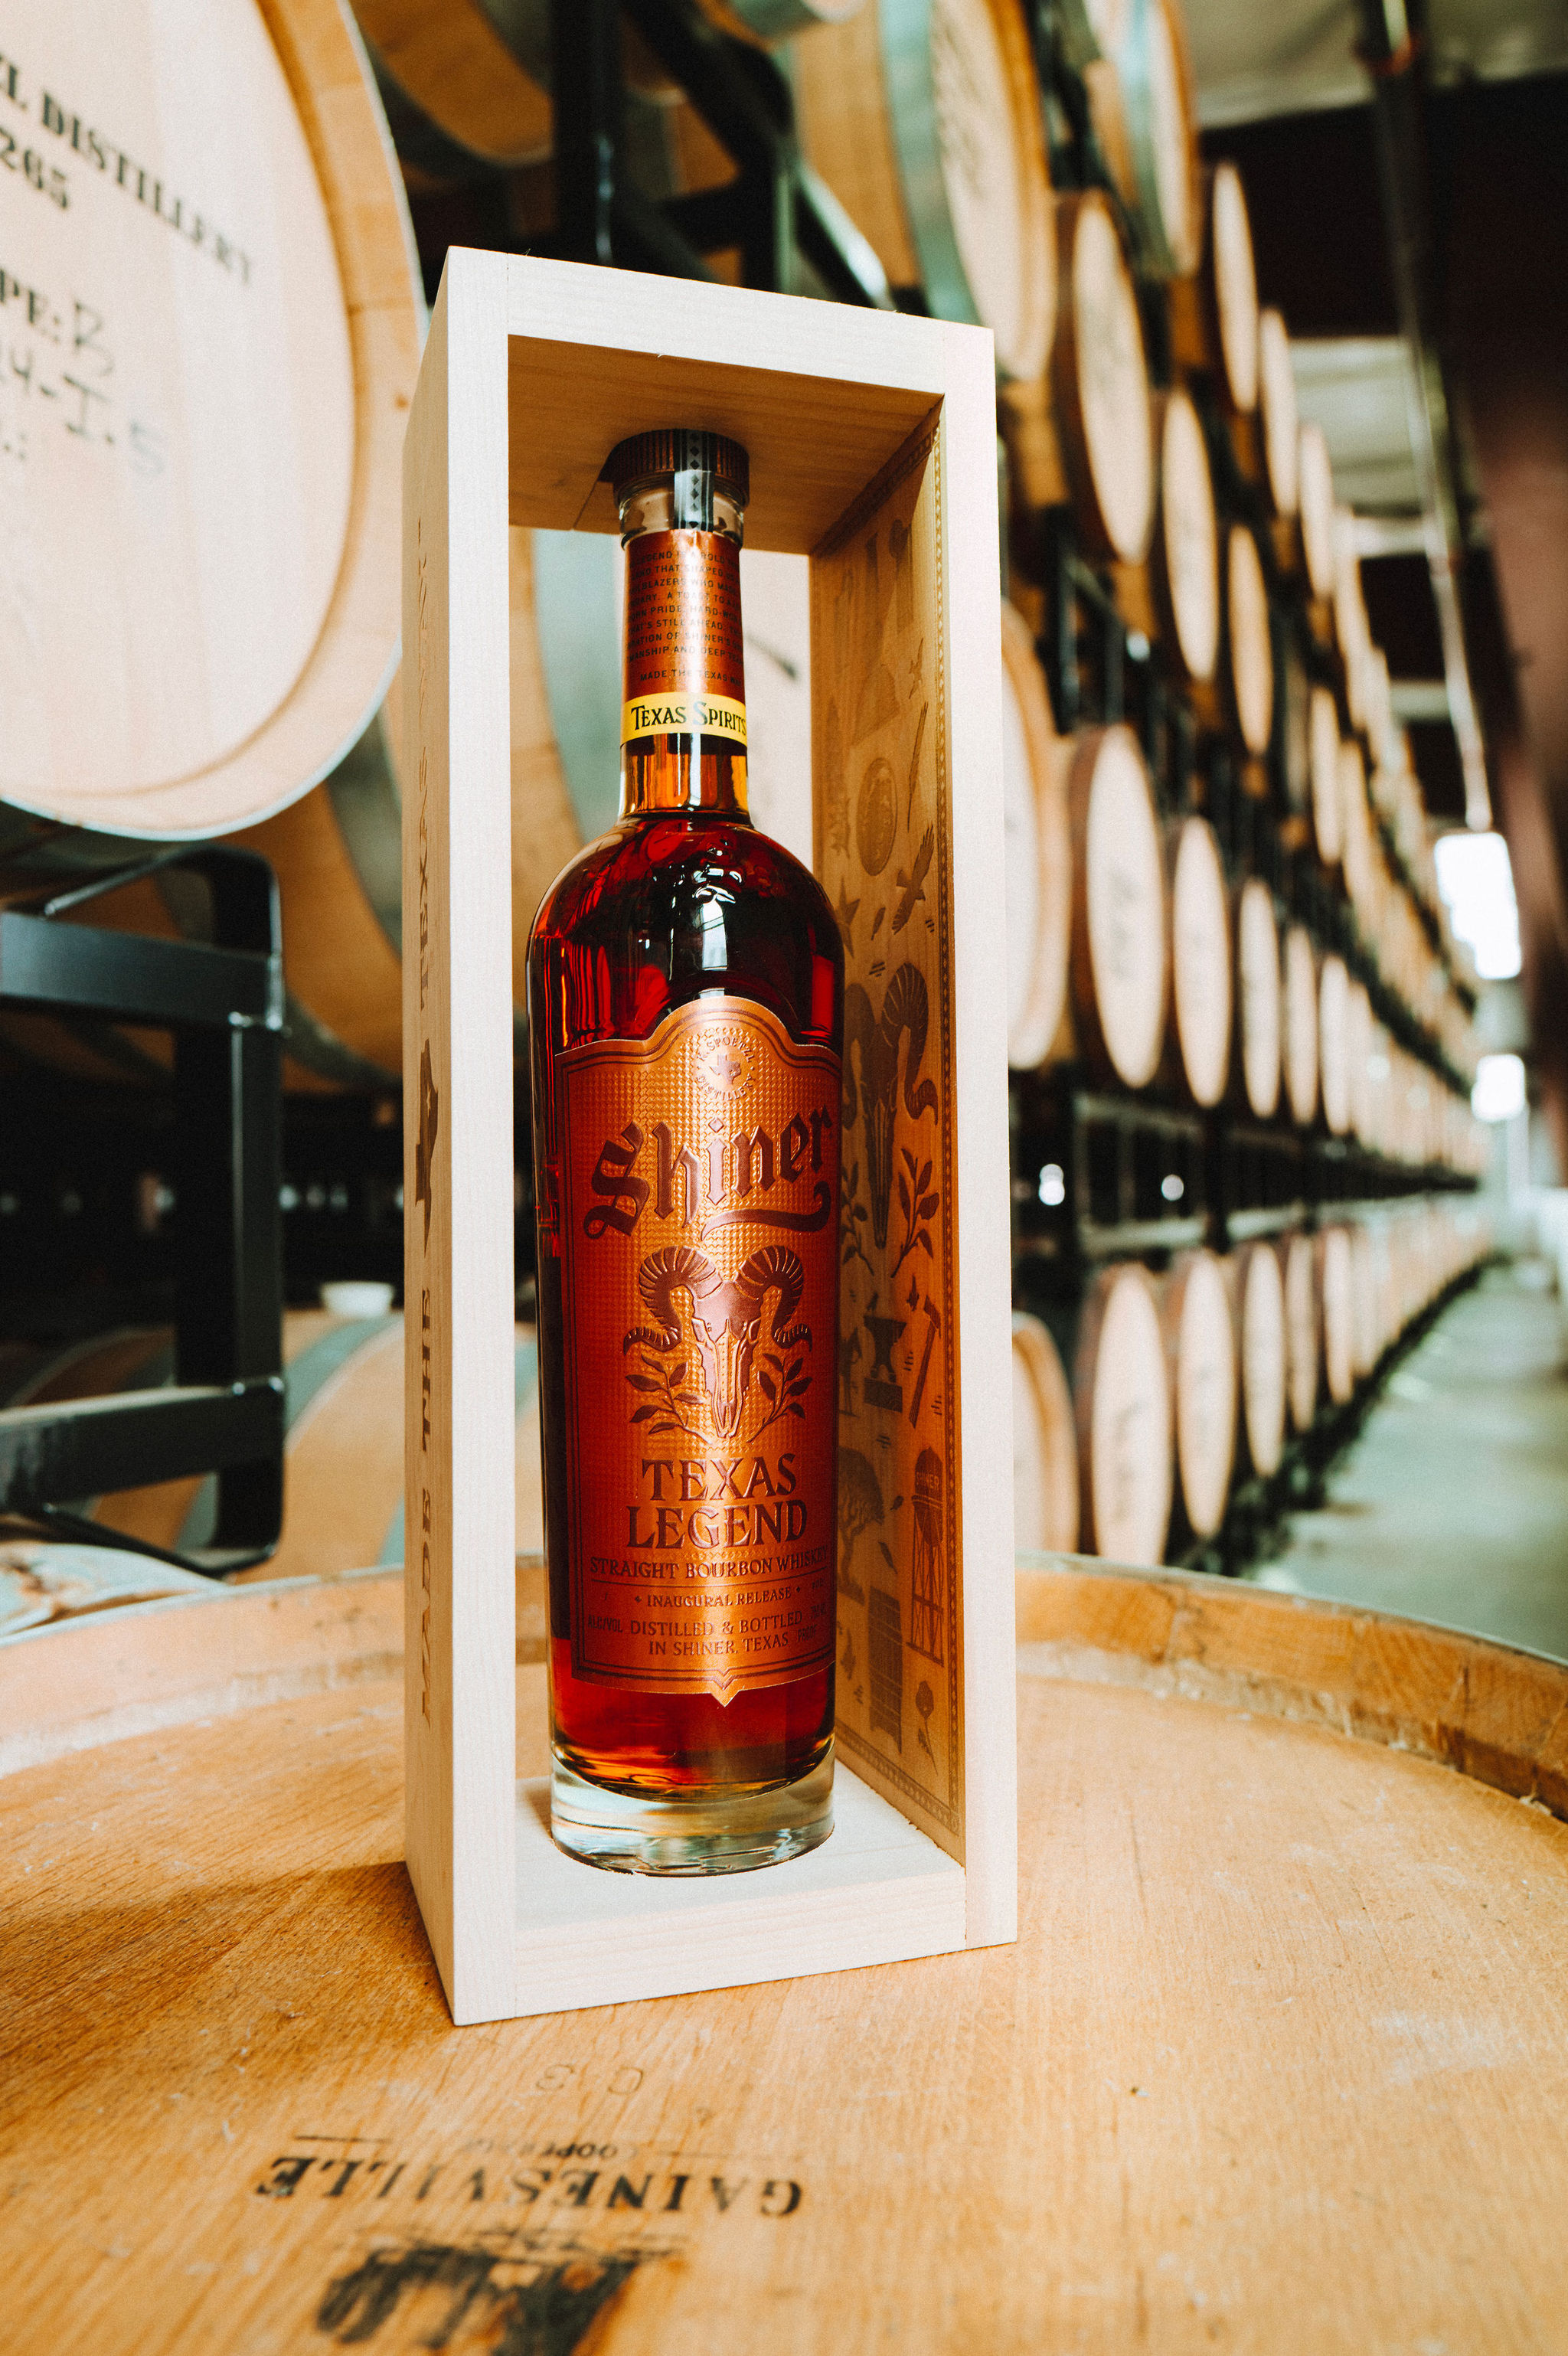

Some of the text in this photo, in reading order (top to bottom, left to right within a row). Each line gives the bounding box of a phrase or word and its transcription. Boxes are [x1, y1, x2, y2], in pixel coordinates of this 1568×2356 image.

[41, 86, 252, 288] DISTILLERY
[701, 552, 725, 564] BOLD
[655, 564, 680, 573] THAT
[684, 564, 724, 577] SHAPED
[692, 579, 714, 588] WHO
[714, 595, 725, 603] TO
[656, 618, 686, 628] STILL
[666, 632, 680, 641] OF
[674, 645, 696, 654] AND
[701, 647, 725, 658] DEEP
[640, 669, 667, 682] MADE
[671, 668, 691, 677] THE
[698, 670, 727, 681] TEXAS
[630, 701, 746, 736] TEXAS SPIRITS
[583, 1103, 834, 1241] Shiner
[642, 1452, 797, 1502] TEXAS
[626, 1498, 808, 1550] LEGEND
[590, 1544, 828, 1580] STRAIGHT BOURBON WHISKEY
[647, 1586, 792, 1608] INAUGURAL RELEASE
[630, 1619, 714, 1637] DISTILLED
[722, 1621, 733, 1635] &
[740, 1610, 802, 1634] BOTTLED
[648, 1641, 666, 1655] IN
[745, 1633, 789, 1652] TEXAS
[253, 2155, 804, 2218] GAINESVILLE
